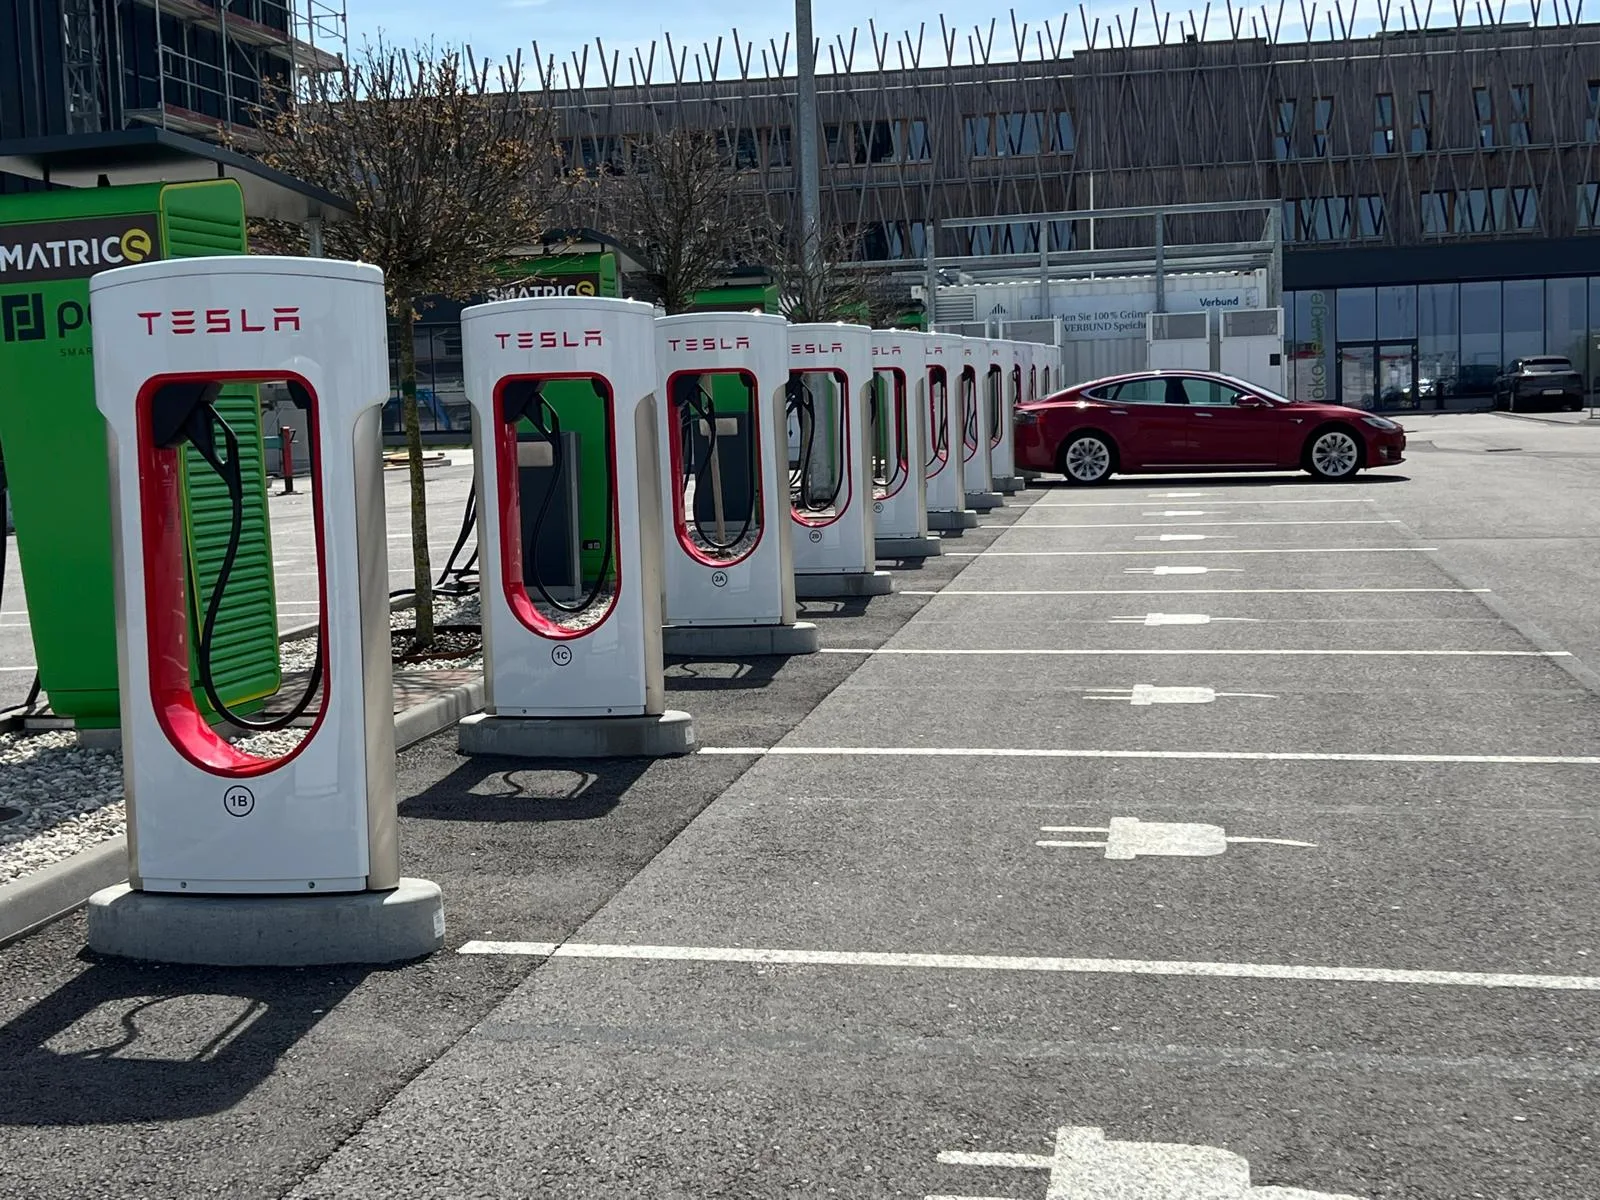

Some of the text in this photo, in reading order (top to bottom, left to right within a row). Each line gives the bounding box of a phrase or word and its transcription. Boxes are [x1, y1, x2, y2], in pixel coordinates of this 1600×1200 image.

[1200, 296, 1239, 307] Verbund
[57, 301, 92, 338] p
[137, 307, 300, 335] TESLA
[1078, 312, 1092, 321] Sie
[1064, 321, 1112, 332] VERBUND
[495, 330, 603, 350] TESLA
[668, 337, 750, 352] TESLA
[791, 343, 842, 354] ESLA
[230, 795, 248, 807] 1B
